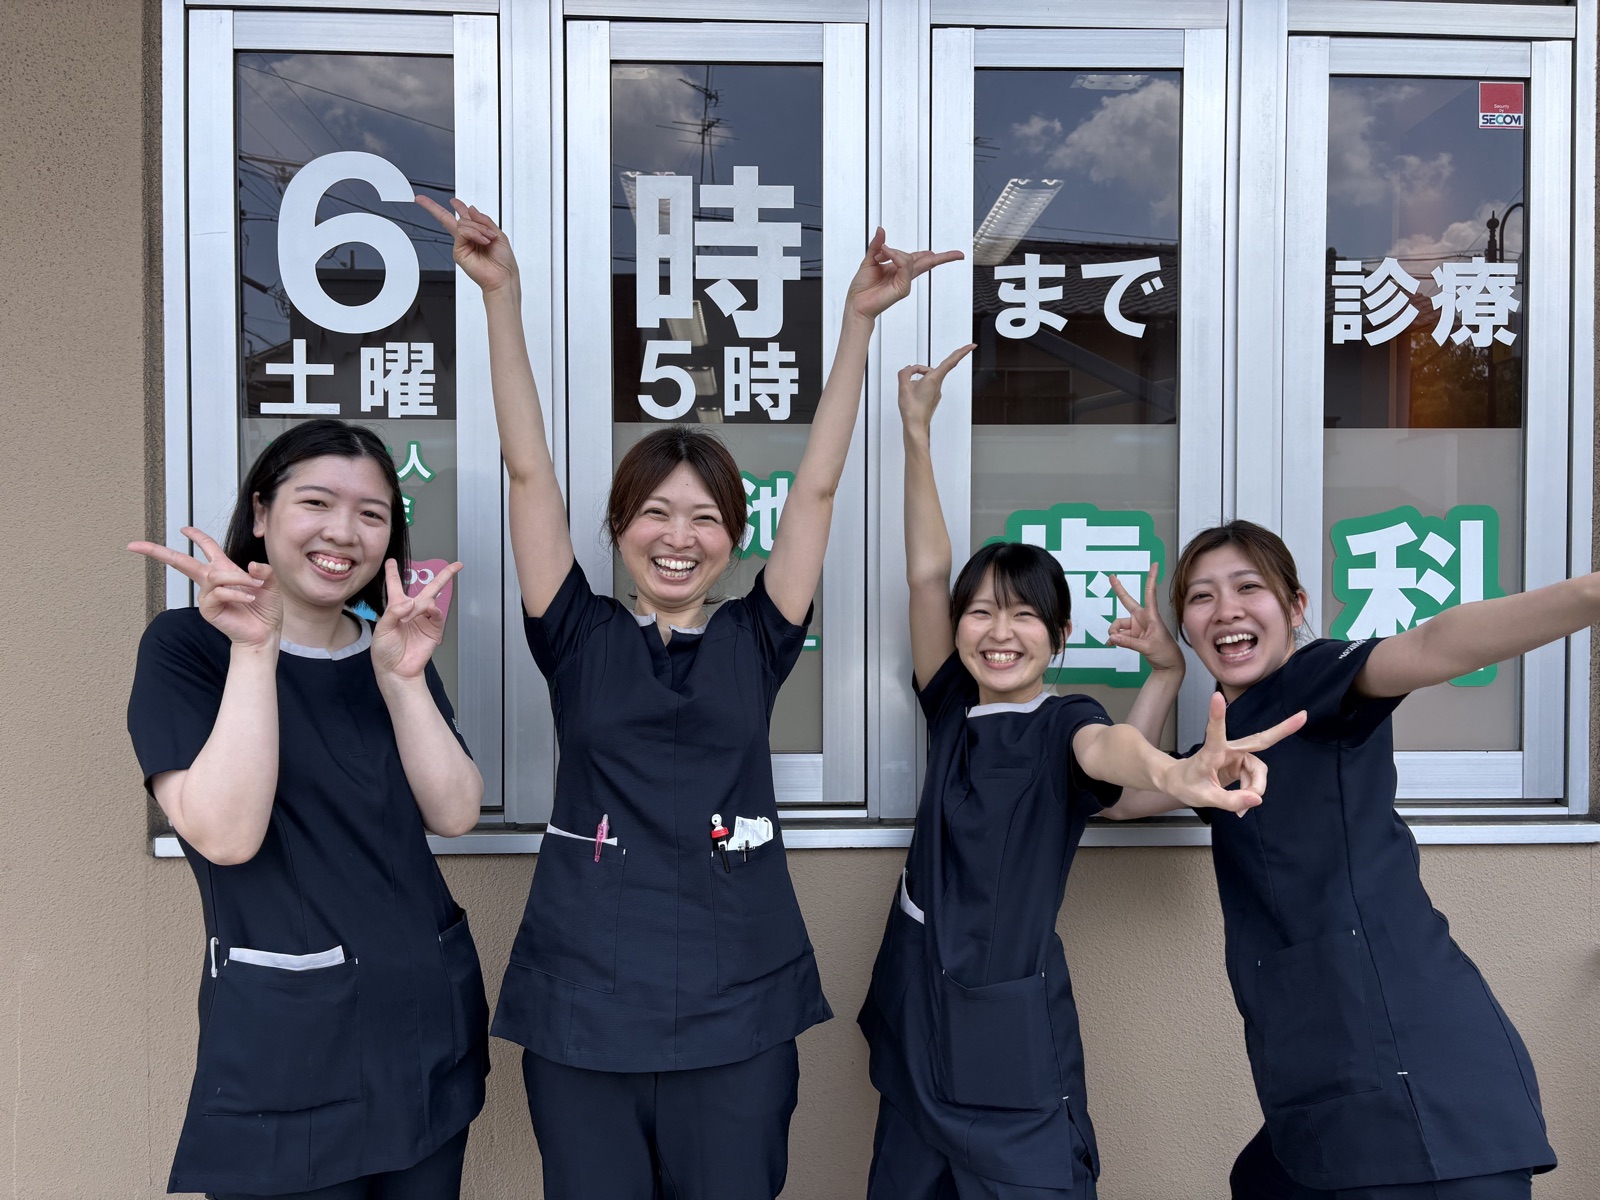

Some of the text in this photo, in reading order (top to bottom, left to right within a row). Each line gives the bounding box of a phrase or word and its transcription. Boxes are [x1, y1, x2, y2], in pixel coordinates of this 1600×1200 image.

[1481, 114, 1521, 125] SECOM
[277, 151, 1521, 347] 6 時 まで 診療
[260, 339, 437, 418] 土曜
